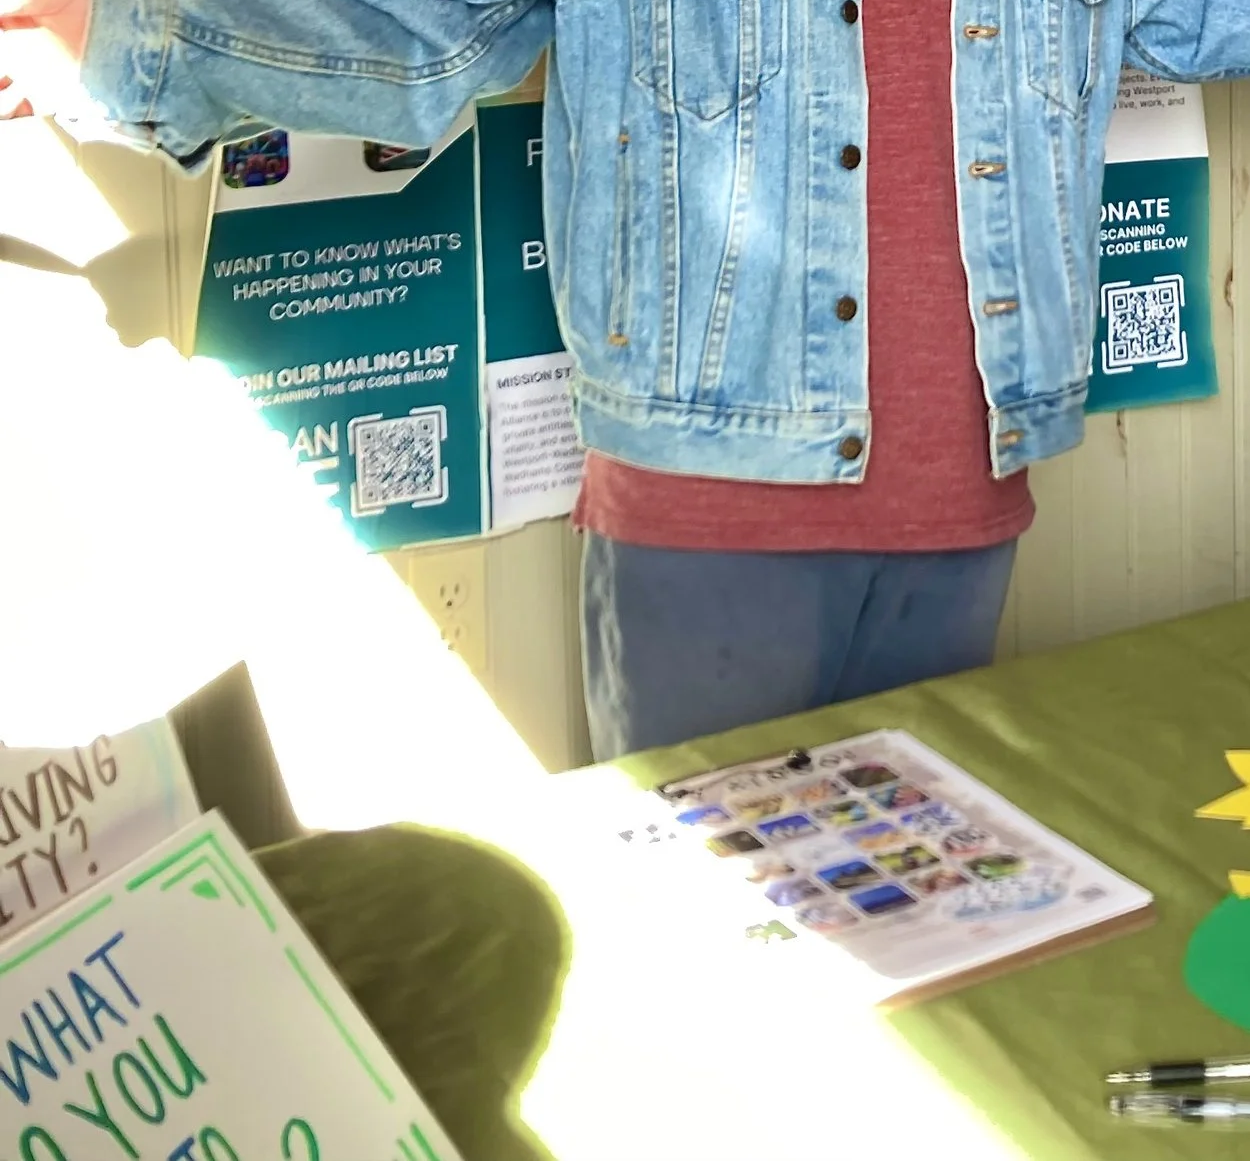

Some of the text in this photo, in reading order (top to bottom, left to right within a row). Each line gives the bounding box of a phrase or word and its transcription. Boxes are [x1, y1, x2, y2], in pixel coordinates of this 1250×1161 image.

[1133, 84, 1176, 95] Westport
[1167, 96, 1186, 107] and
[1100, 222, 1166, 242] SCANNING
[1106, 236, 1189, 257] CODE BELOW
[212, 232, 462, 279] WANT TO KNOW WHAT'S
[232, 257, 443, 302] HAPPENING IN YOUR
[268, 284, 409, 321] COMMUNITY?
[276, 363, 321, 388] OUR
[323, 349, 411, 381] MAILING
[413, 343, 459, 367] LIST
[320, 381, 346, 398] THE
[366, 374, 401, 389] CODE
[403, 366, 449, 384] BELOW
[496, 369, 553, 389] MISSION
[0, 931, 141, 1106] WHAT
[63, 1013, 207, 1160] YOU
